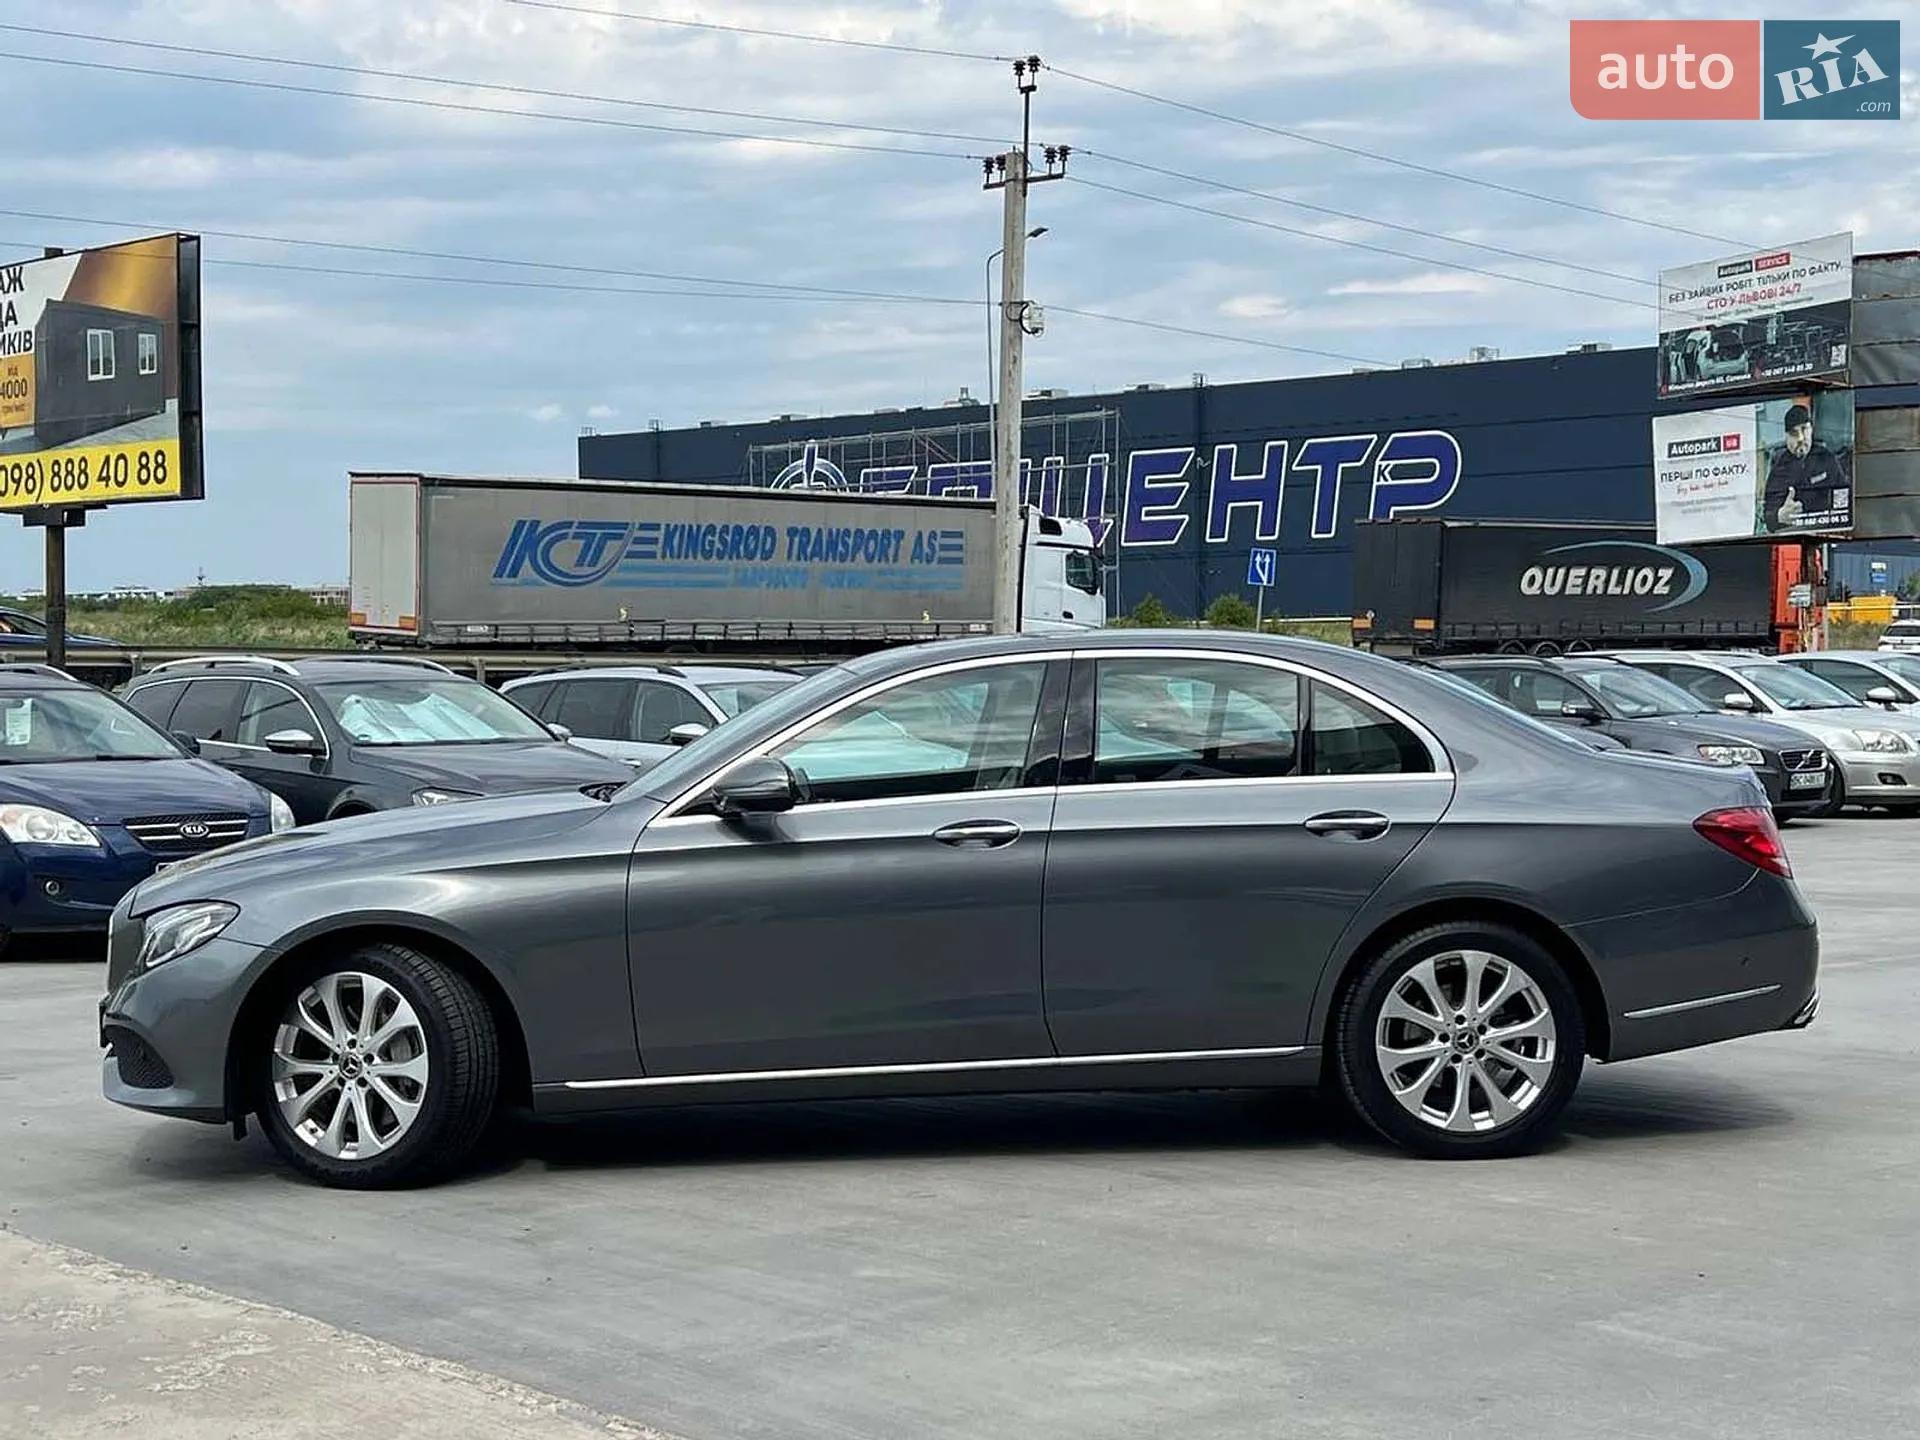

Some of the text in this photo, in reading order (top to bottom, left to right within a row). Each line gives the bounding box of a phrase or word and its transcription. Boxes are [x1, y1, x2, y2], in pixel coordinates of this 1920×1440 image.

[1792, 268, 1807, 279] ПО
[1707, 297, 1728, 310] СТО
[1671, 439, 1718, 455] Autopark
[50, 456, 89, 493] 888
[97, 453, 129, 488] 40
[137, 449, 167, 486] 88
[1660, 470, 1694, 483] ПЕРШІ
[1695, 467, 1710, 479] ПО
[660, 522, 777, 561] KINGSRØD
[786, 526, 905, 565] TRANSPORT
[910, 530, 937, 565] AS
[1520, 566, 1674, 595] QUERLIOZ
[185, 825, 204, 834] KIA
